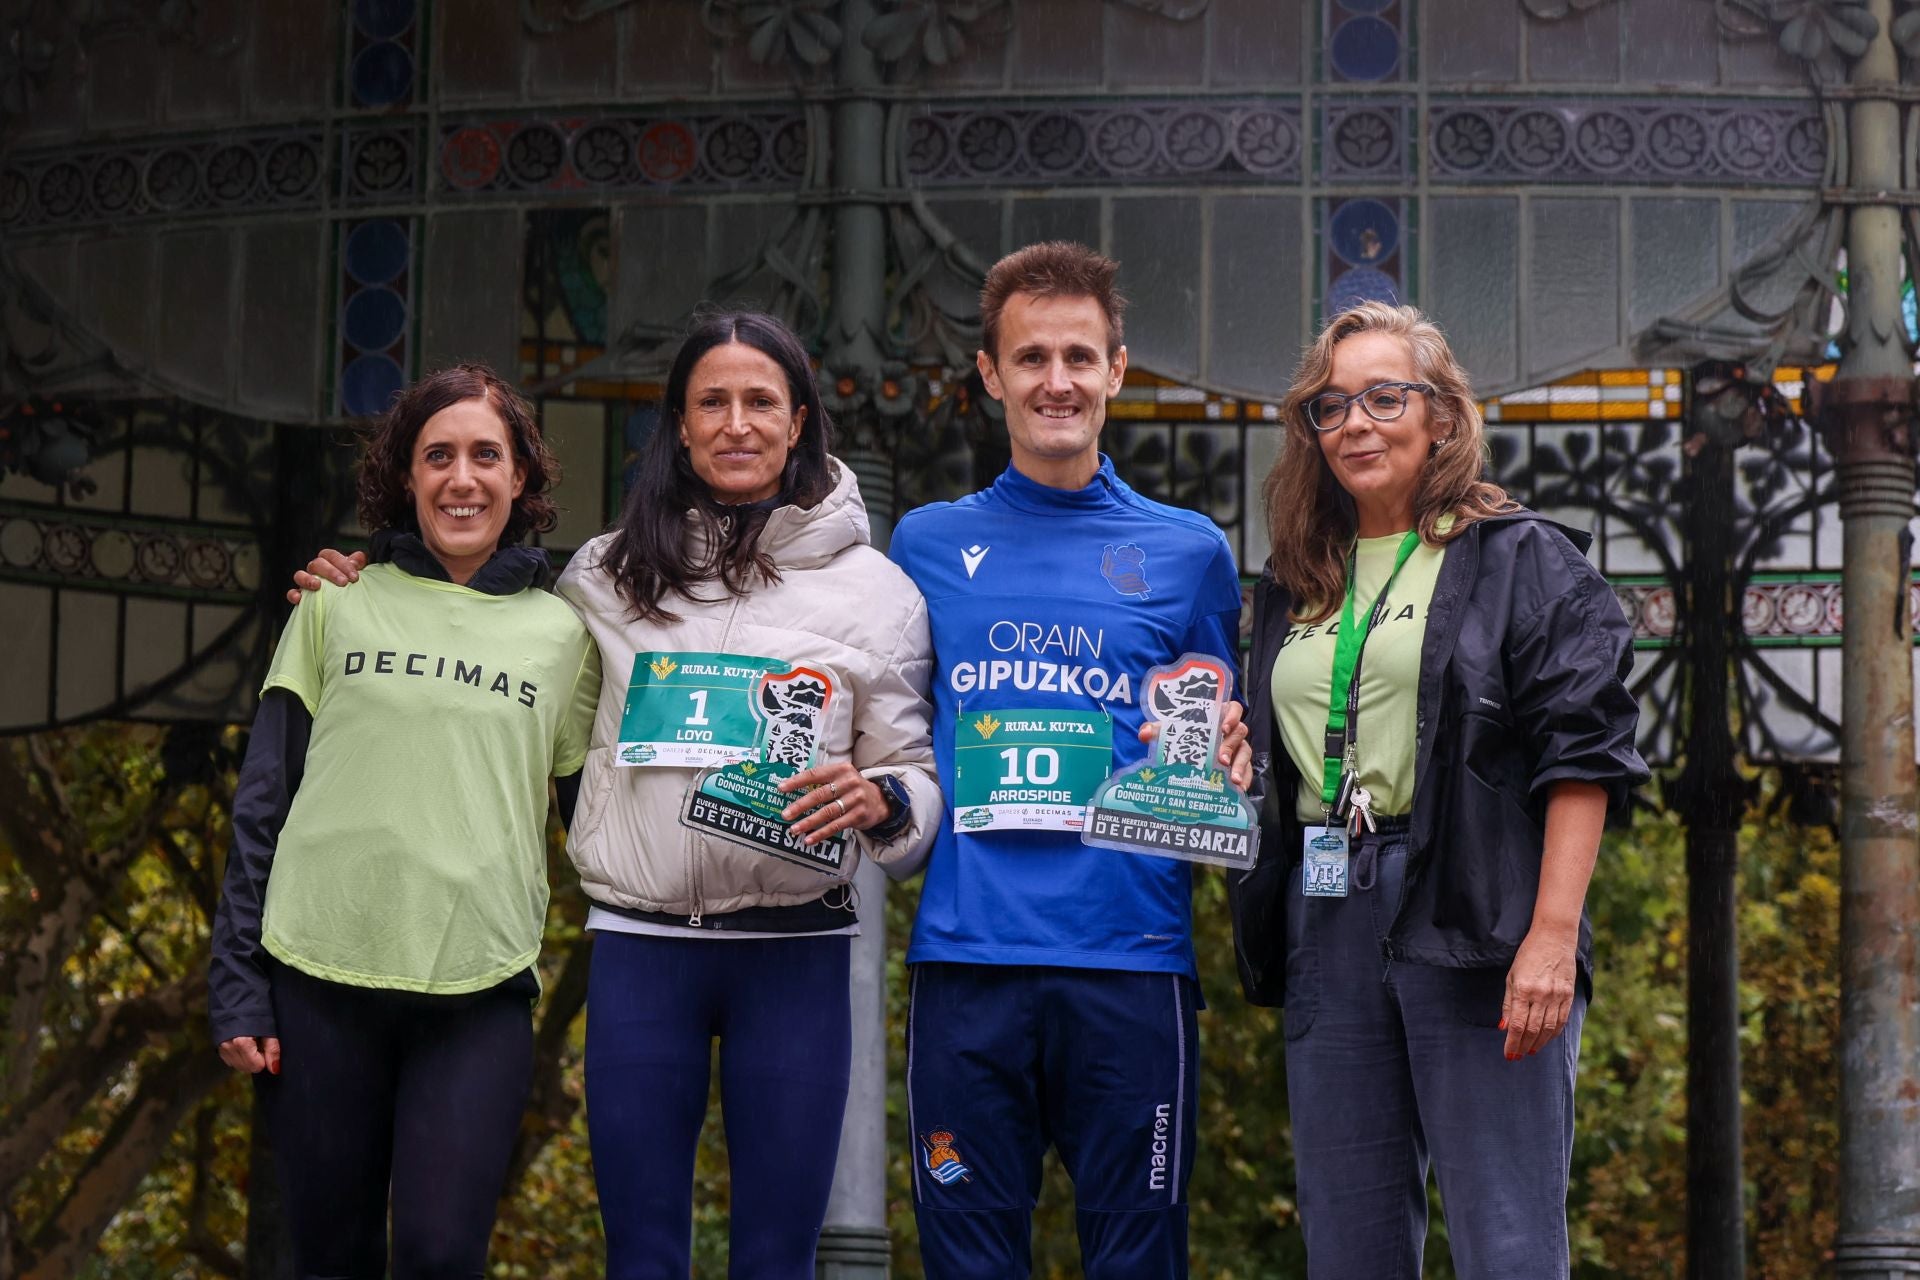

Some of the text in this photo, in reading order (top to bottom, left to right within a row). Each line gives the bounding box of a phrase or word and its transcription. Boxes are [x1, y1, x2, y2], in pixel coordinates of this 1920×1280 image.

[989, 621, 1103, 659] ORAIN
[1282, 603, 1431, 649] DECMA
[345, 651, 537, 708] DECIMAS
[681, 664, 720, 675] RURAL
[951, 661, 1132, 704] GIPUZKOA
[685, 690, 709, 726] 1
[676, 729, 713, 742] LOYO
[1004, 720, 1095, 734] RURAL KUTXA
[1000, 747, 1060, 785] 10
[717, 778, 759, 799] DONOSTIA
[767, 795, 784, 807] SAN
[727, 772, 746, 784] RURAL
[747, 778, 765, 790] KUTXA
[1126, 782, 1145, 791] RURAL
[1146, 786, 1165, 794] KUTXA
[1166, 788, 1185, 797] MEDIO
[1186, 789, 1213, 800] MARATÓN
[989, 789, 1072, 803] ARROSPIDE
[1117, 789, 1159, 805] DONOSTIA
[1168, 798, 1186, 809] SAN
[1188, 800, 1236, 816] SEBASTIÁN
[693, 805, 781, 844] DECIMAS
[696, 798, 718, 811] EUSKAL
[719, 805, 746, 819] HERRIKO
[746, 813, 783, 832] TXAPELDUNA
[1035, 808, 1072, 816] DECIMAS
[1097, 814, 1120, 824] EUSKAL
[1121, 817, 1148, 828] HERRIKO
[1149, 821, 1187, 833] TXAPELDUNA
[1095, 821, 1248, 856] DECIMAS SARIA
[1308, 864, 1344, 884] VIP
[1150, 1103, 1170, 1190] macron
